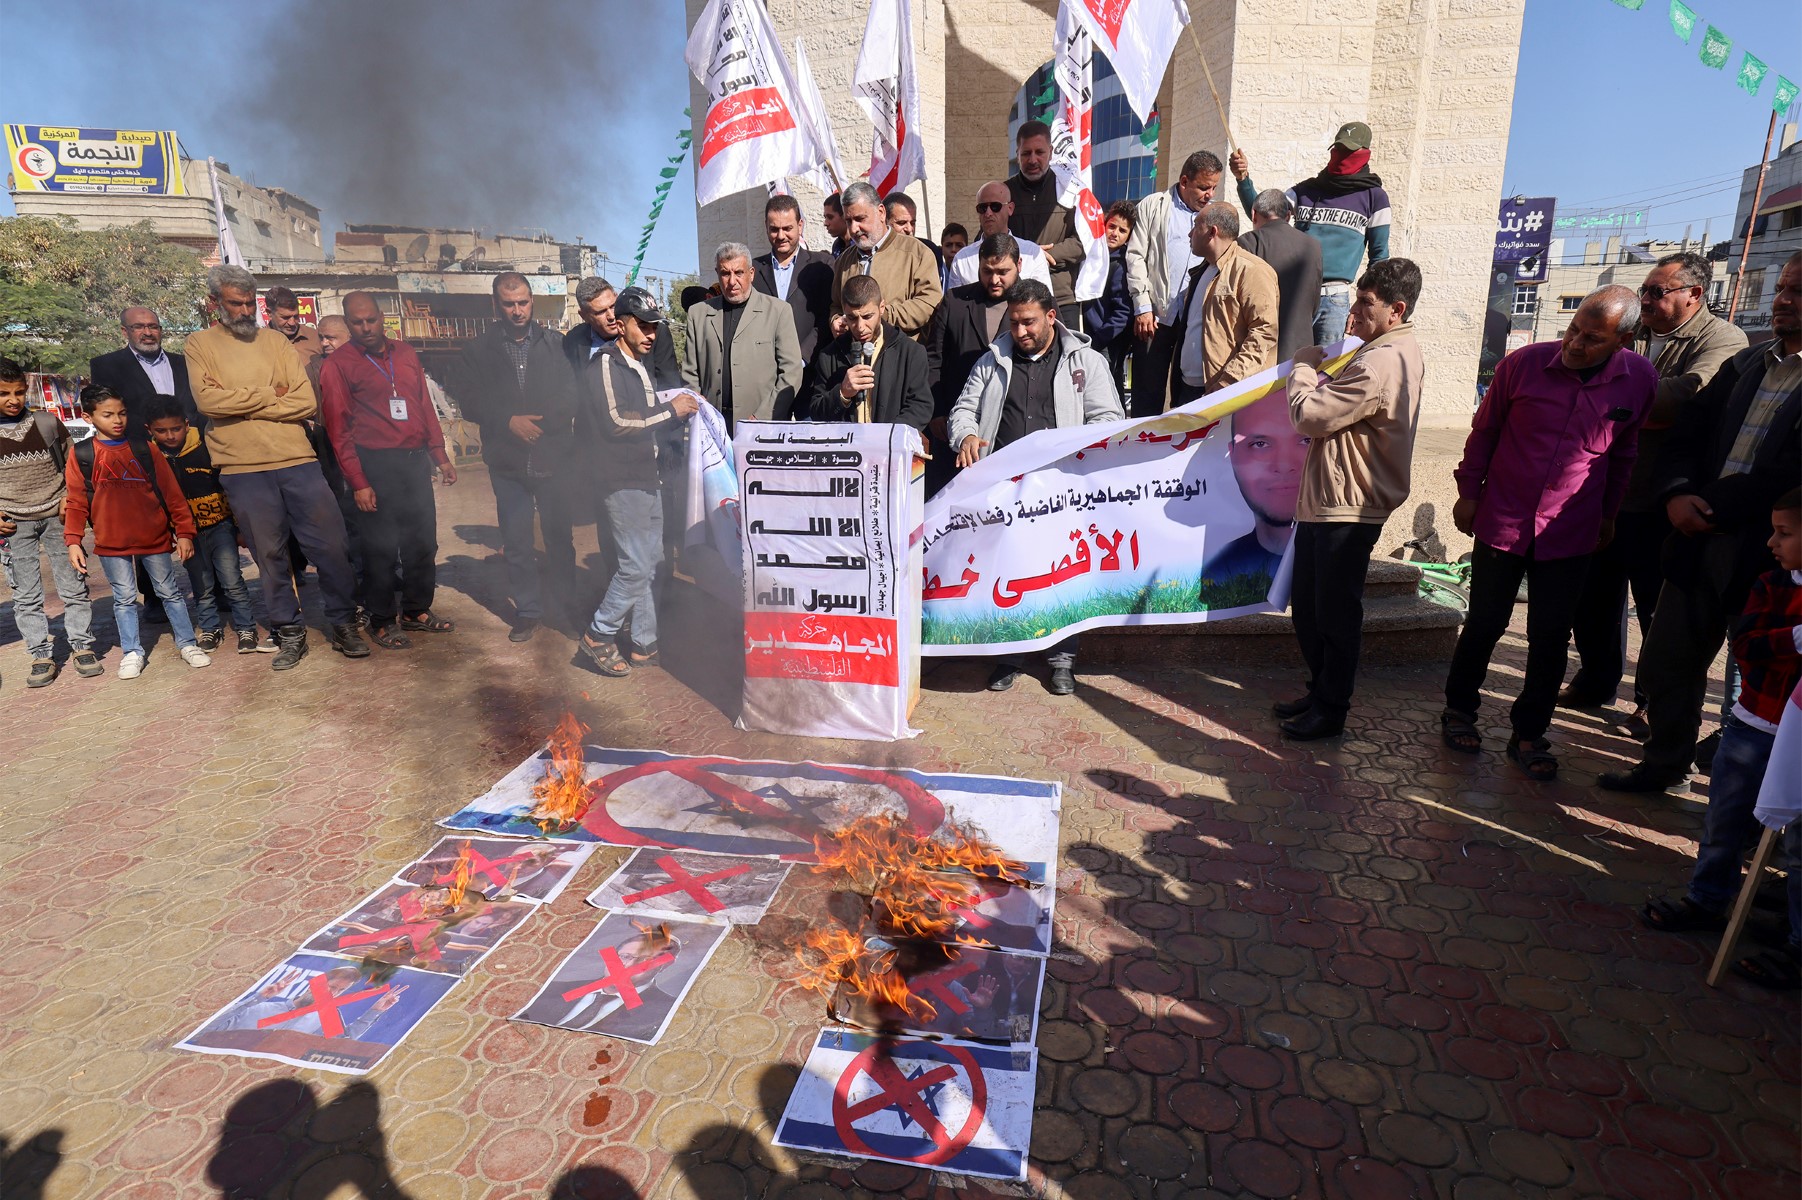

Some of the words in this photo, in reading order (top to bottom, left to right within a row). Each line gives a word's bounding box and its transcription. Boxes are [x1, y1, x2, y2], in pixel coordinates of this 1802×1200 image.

[718, 74, 759, 97] رسول
[701, 96, 783, 150] المجاهدي
[42, 129, 76, 139] المركزية
[121, 132, 152, 143] صيدلية
[67, 142, 136, 165] النجمة
[1322, 208, 1341, 222] THE
[1498, 241, 1527, 249] فواتيرك
[754, 432, 785, 444] لله
[787, 431, 854, 447] البيعة
[749, 453, 775, 464] جهاد
[785, 454, 817, 466] إخلاص
[832, 453, 859, 465] دعوة
[870, 464, 882, 485] عقيدة
[1067, 483, 1149, 512] الجماهيرية
[1153, 478, 1207, 501] الوقفة
[1014, 492, 1068, 523] الغاضبة
[749, 516, 833, 537] الله
[837, 517, 861, 537] إلا
[756, 552, 867, 570] محمد
[992, 523, 1140, 609] الأقصى
[757, 577, 796, 606] الله
[802, 588, 867, 614] رسول
[875, 589, 888, 612] جهادية
[799, 614, 828, 639] حركة
[744, 630, 893, 661] المجاهدين
